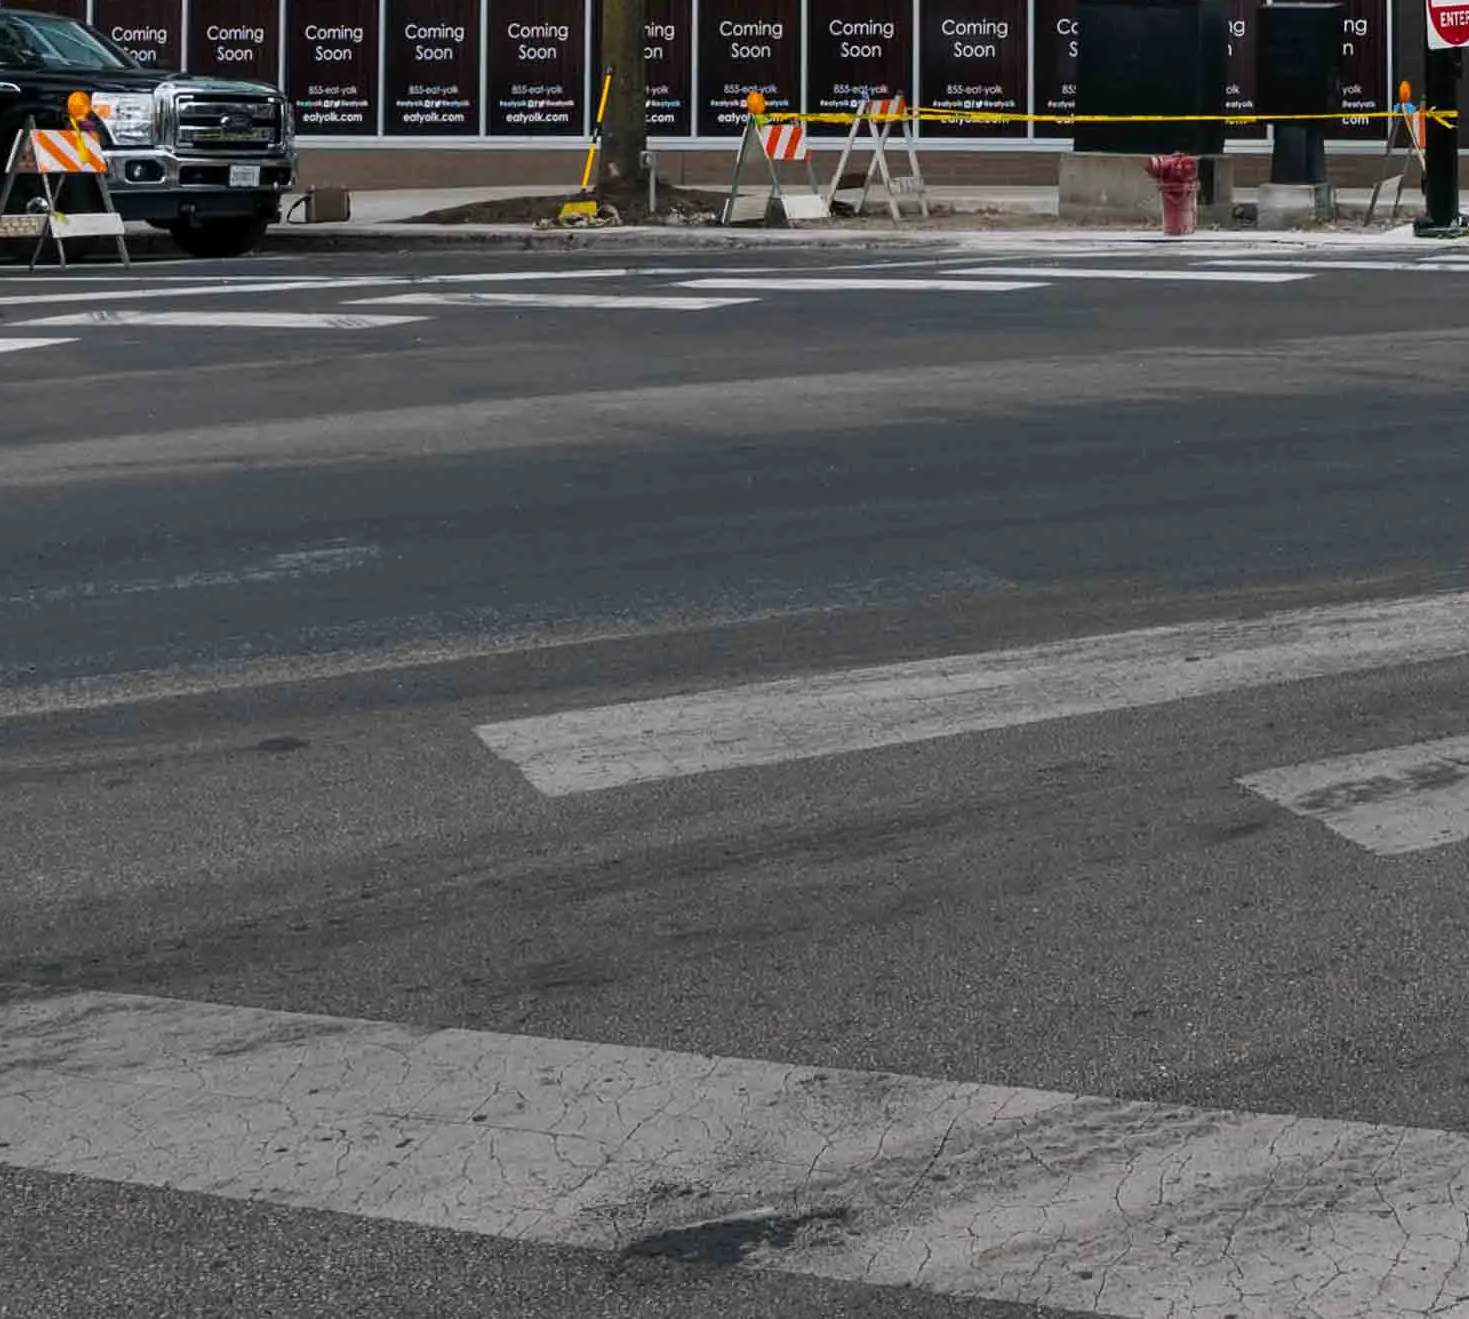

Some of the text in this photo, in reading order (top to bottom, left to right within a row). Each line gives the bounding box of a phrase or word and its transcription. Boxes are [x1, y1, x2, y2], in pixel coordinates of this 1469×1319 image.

[111, 26, 167, 44] Coming
[206, 25, 264, 43] Coming
[305, 24, 363, 42] Coming
[405, 24, 464, 42] Coming
[507, 23, 569, 41] Coming
[644, 22, 675, 40] ing
[719, 20, 782, 39] Coming
[829, 19, 894, 39] Coming
[942, 18, 1009, 39] Coming
[123, 47, 156, 60] oon
[217, 45, 253, 61] Soon
[315, 45, 352, 61] Soon
[415, 45, 453, 60] Soon
[518, 44, 557, 60] Soon
[644, 47, 663, 59] on
[731, 42, 771, 57] Soon
[841, 42, 882, 57] Soon
[953, 42, 995, 58] Soon
[302, 111, 362, 124] eatyolk.com
[403, 112, 464, 124] eatyolk.com
[506, 112, 569, 124] eatyolk.com
